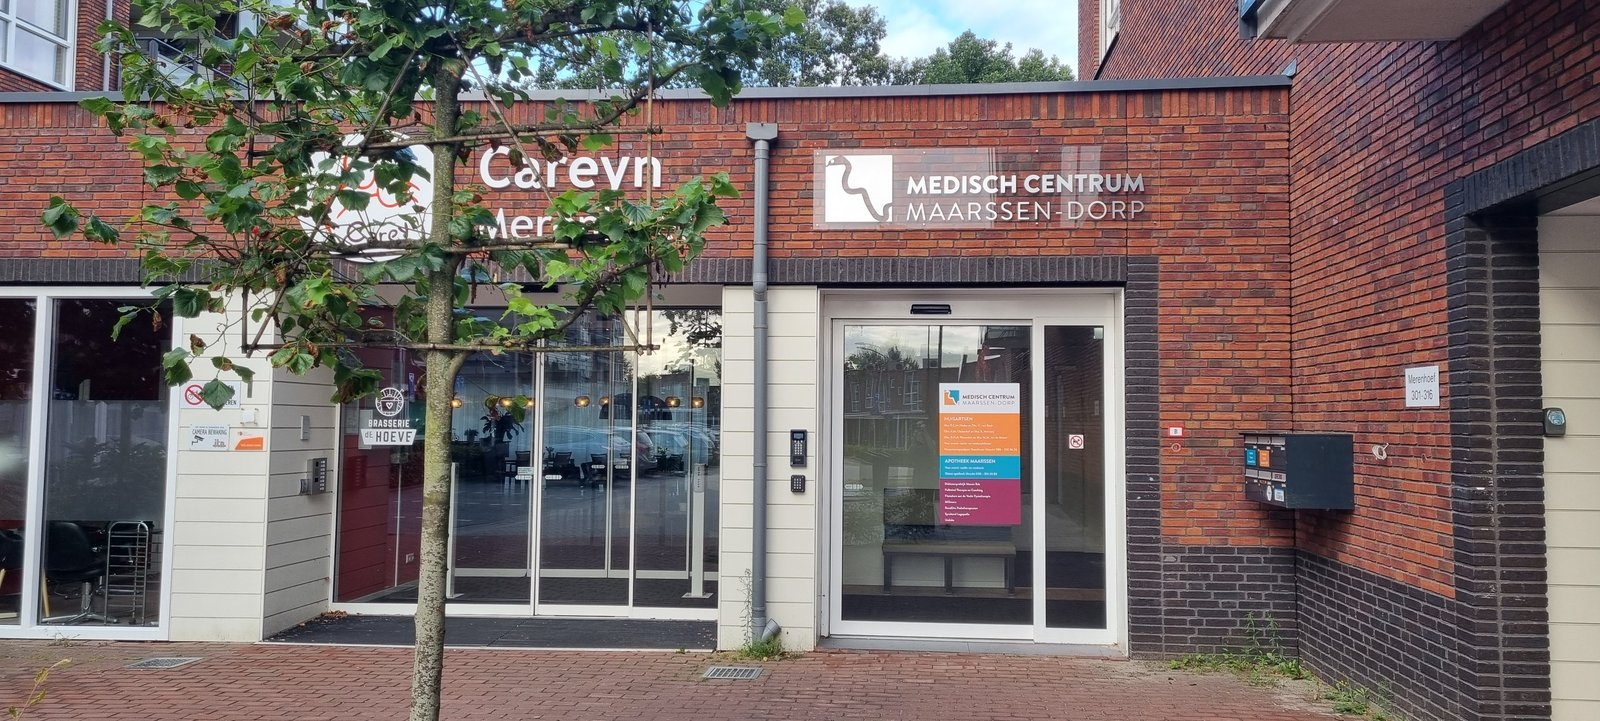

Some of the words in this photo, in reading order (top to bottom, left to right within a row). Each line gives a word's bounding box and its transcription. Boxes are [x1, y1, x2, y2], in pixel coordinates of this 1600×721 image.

[480, 146, 662, 191] Careyn
[906, 174, 1017, 195] MEDISCH
[1023, 173, 1145, 194] CENTRUM
[906, 200, 1145, 222] MAARSSEN-DORP
[1408, 372, 1436, 384] Merenhoef
[1411, 389, 1433, 401] 301-316
[368, 419, 410, 428] BRASSERIE
[375, 431, 413, 442] HOEVE
